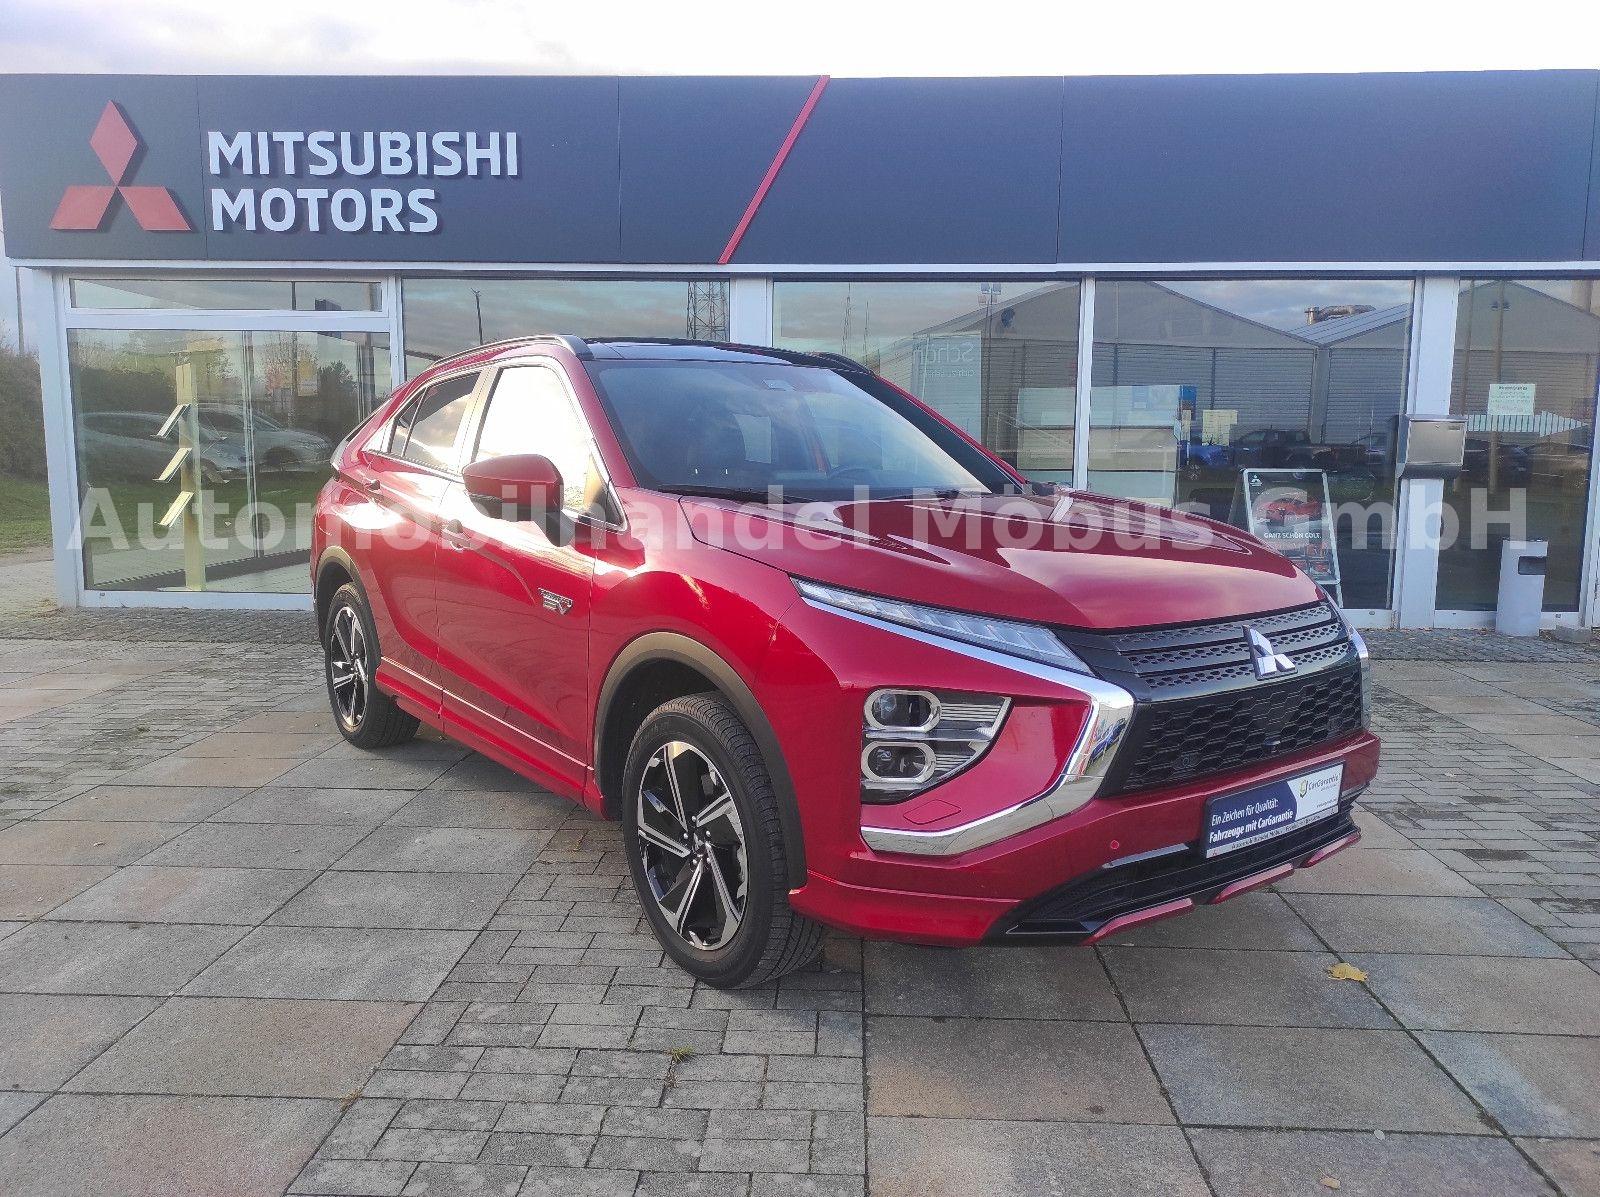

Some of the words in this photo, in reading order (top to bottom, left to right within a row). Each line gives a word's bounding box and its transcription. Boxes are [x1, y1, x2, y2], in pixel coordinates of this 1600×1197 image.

[207, 130, 519, 177] MITSUBISHI
[212, 187, 439, 233] MOTORS
[1209, 825, 1245, 844] Fahrzeuge
[1245, 820, 1257, 833] mit
[1257, 809, 1294, 829] CarGarantie
[1211, 813, 1222, 827] Ein
[1222, 807, 1245, 824] Zeichen
[1245, 804, 1255, 818] für
[1254, 798, 1279, 814] Qualität:
